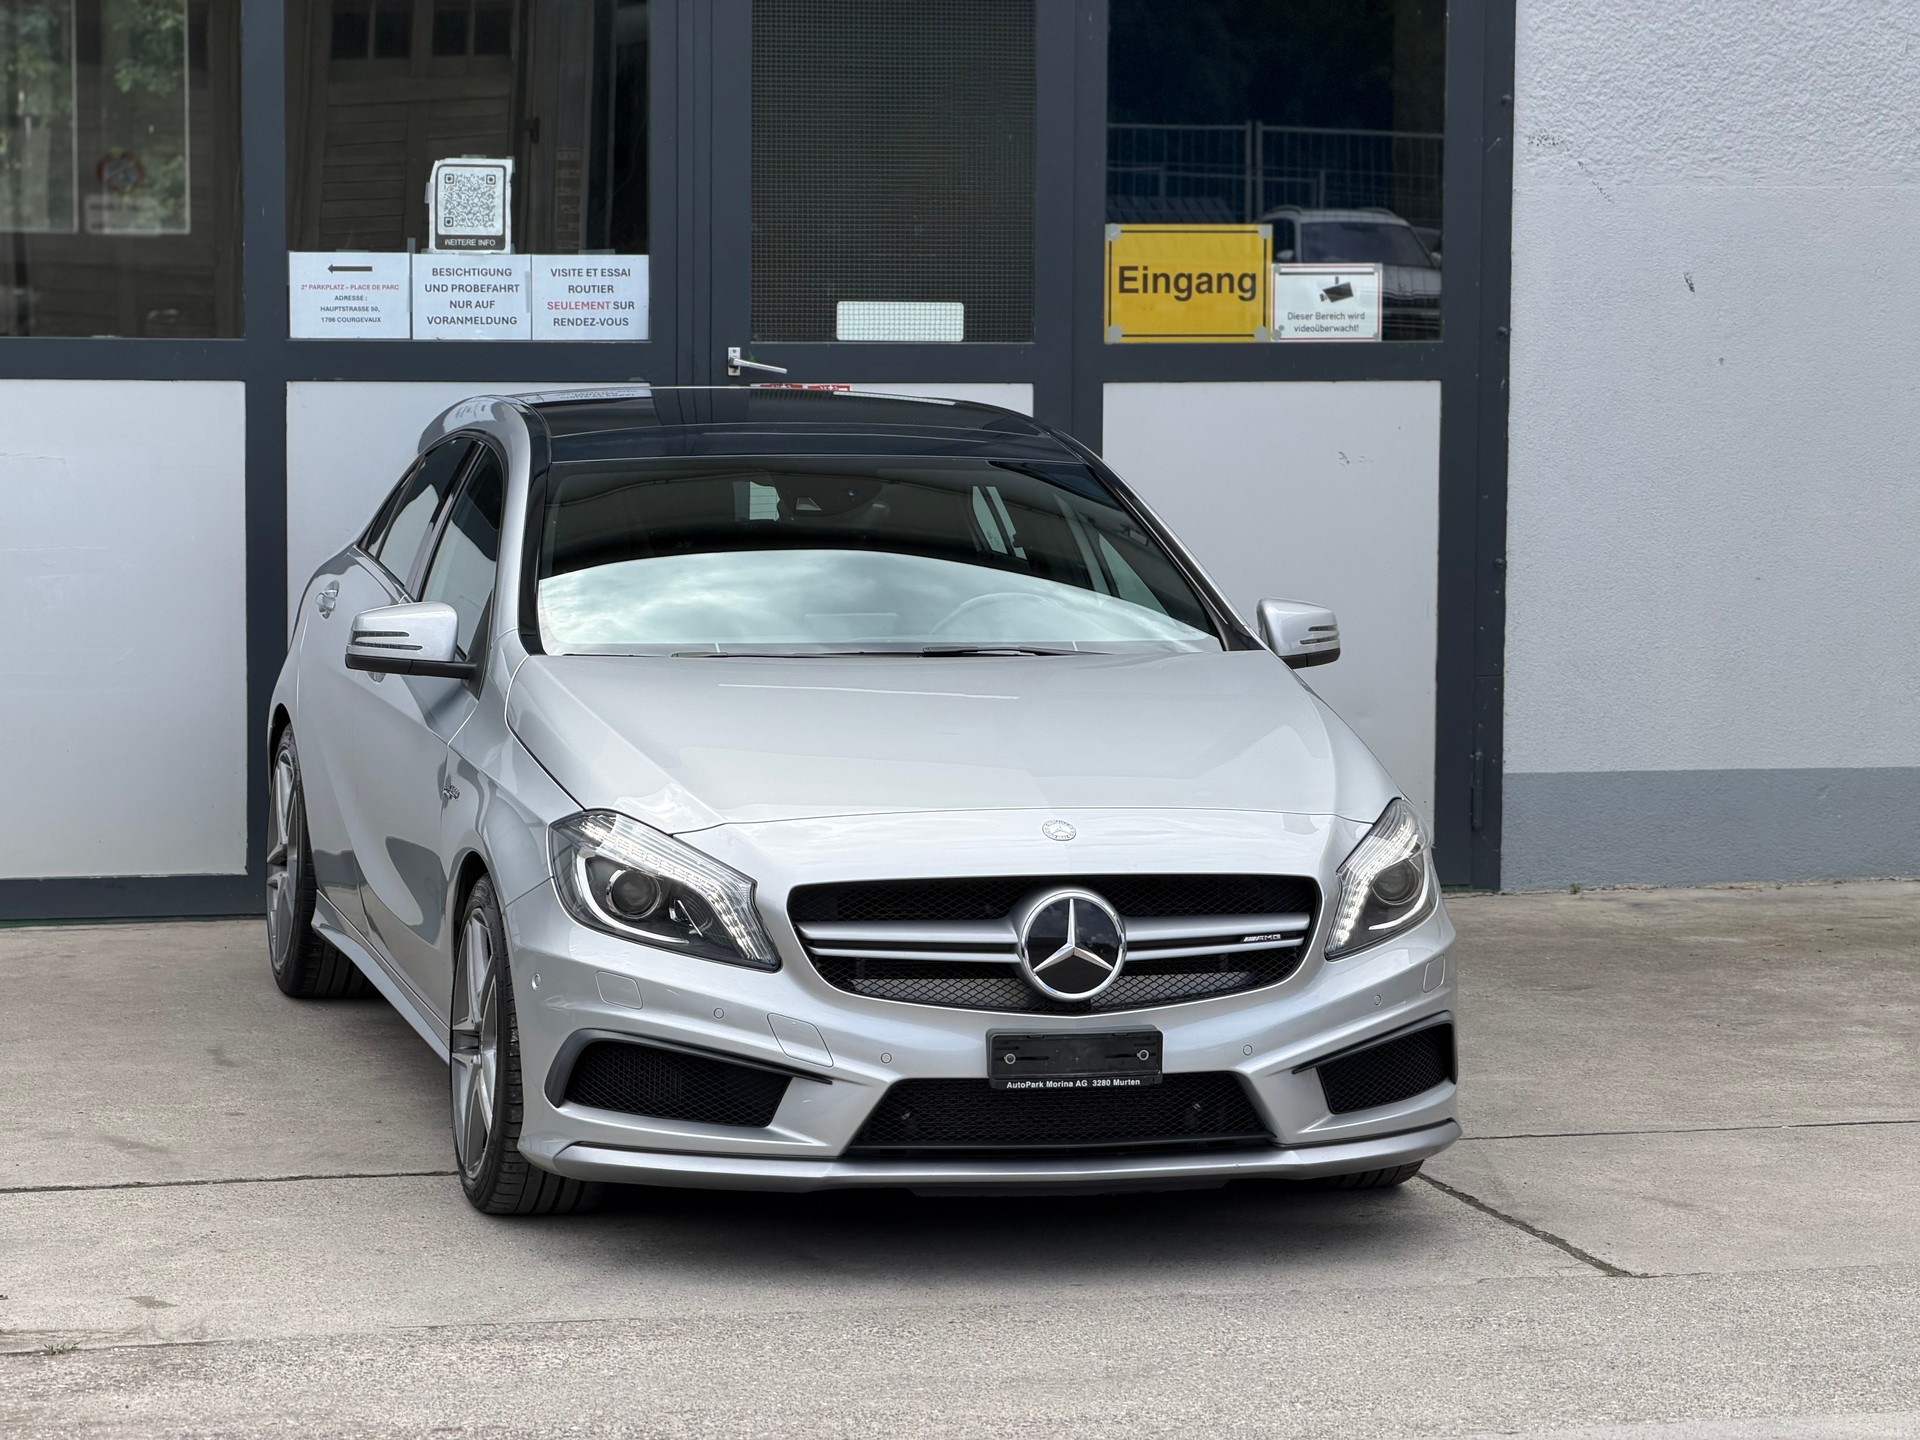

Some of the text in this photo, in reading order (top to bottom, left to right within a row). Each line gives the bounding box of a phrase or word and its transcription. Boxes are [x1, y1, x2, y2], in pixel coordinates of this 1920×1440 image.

[445, 238, 476, 246] WEITERE
[432, 267, 512, 278] BESICHTIGUNG
[550, 267, 631, 277] VISITE ET ESSAI
[425, 283, 520, 293] UND PROBEFAHRT
[1118, 265, 1257, 302] Eingang
[568, 284, 614, 294] ROUTIER
[449, 300, 495, 309] NUR AUF
[547, 300, 635, 310] SEULEMENT SUR
[427, 315, 517, 326] VORANMELDUNG
[1287, 312, 1365, 320] Dieser Bereich wird
[553, 317, 629, 327] RENDEZ-VOUS
[1294, 324, 1359, 332] videoüberwacht!
[1006, 1081, 1044, 1089] AutoPark
[1046, 1080, 1073, 1088] Morina
[1092, 1079, 1111, 1087] 3280
[1113, 1078, 1140, 1086] Murten
